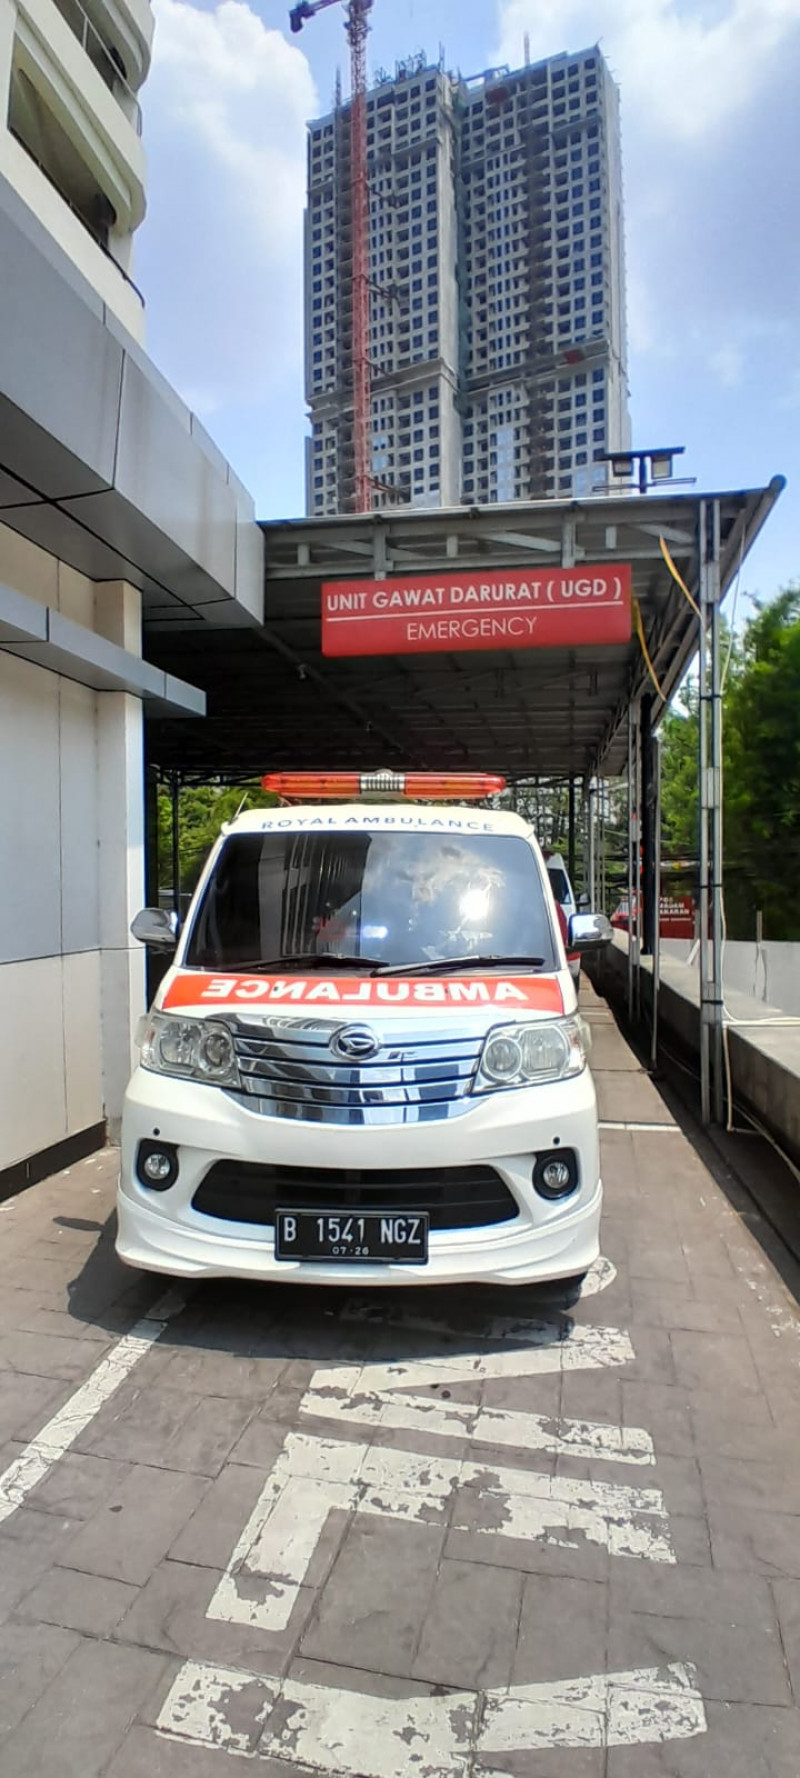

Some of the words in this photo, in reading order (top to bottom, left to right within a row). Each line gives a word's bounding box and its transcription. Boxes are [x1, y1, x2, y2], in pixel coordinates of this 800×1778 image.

[327, 593, 366, 612] UNIT
[372, 588, 445, 608] GAWAT
[450, 582, 540, 604] DARURAT
[561, 578, 607, 598] UGD
[407, 617, 537, 641] EMERGENCY
[260, 817, 337, 830] ROYAL
[343, 817, 495, 832] AMBULANCE
[283, 1217, 297, 1242] B
[317, 1218, 366, 1243] 1541
[380, 1219, 421, 1244] NGZ
